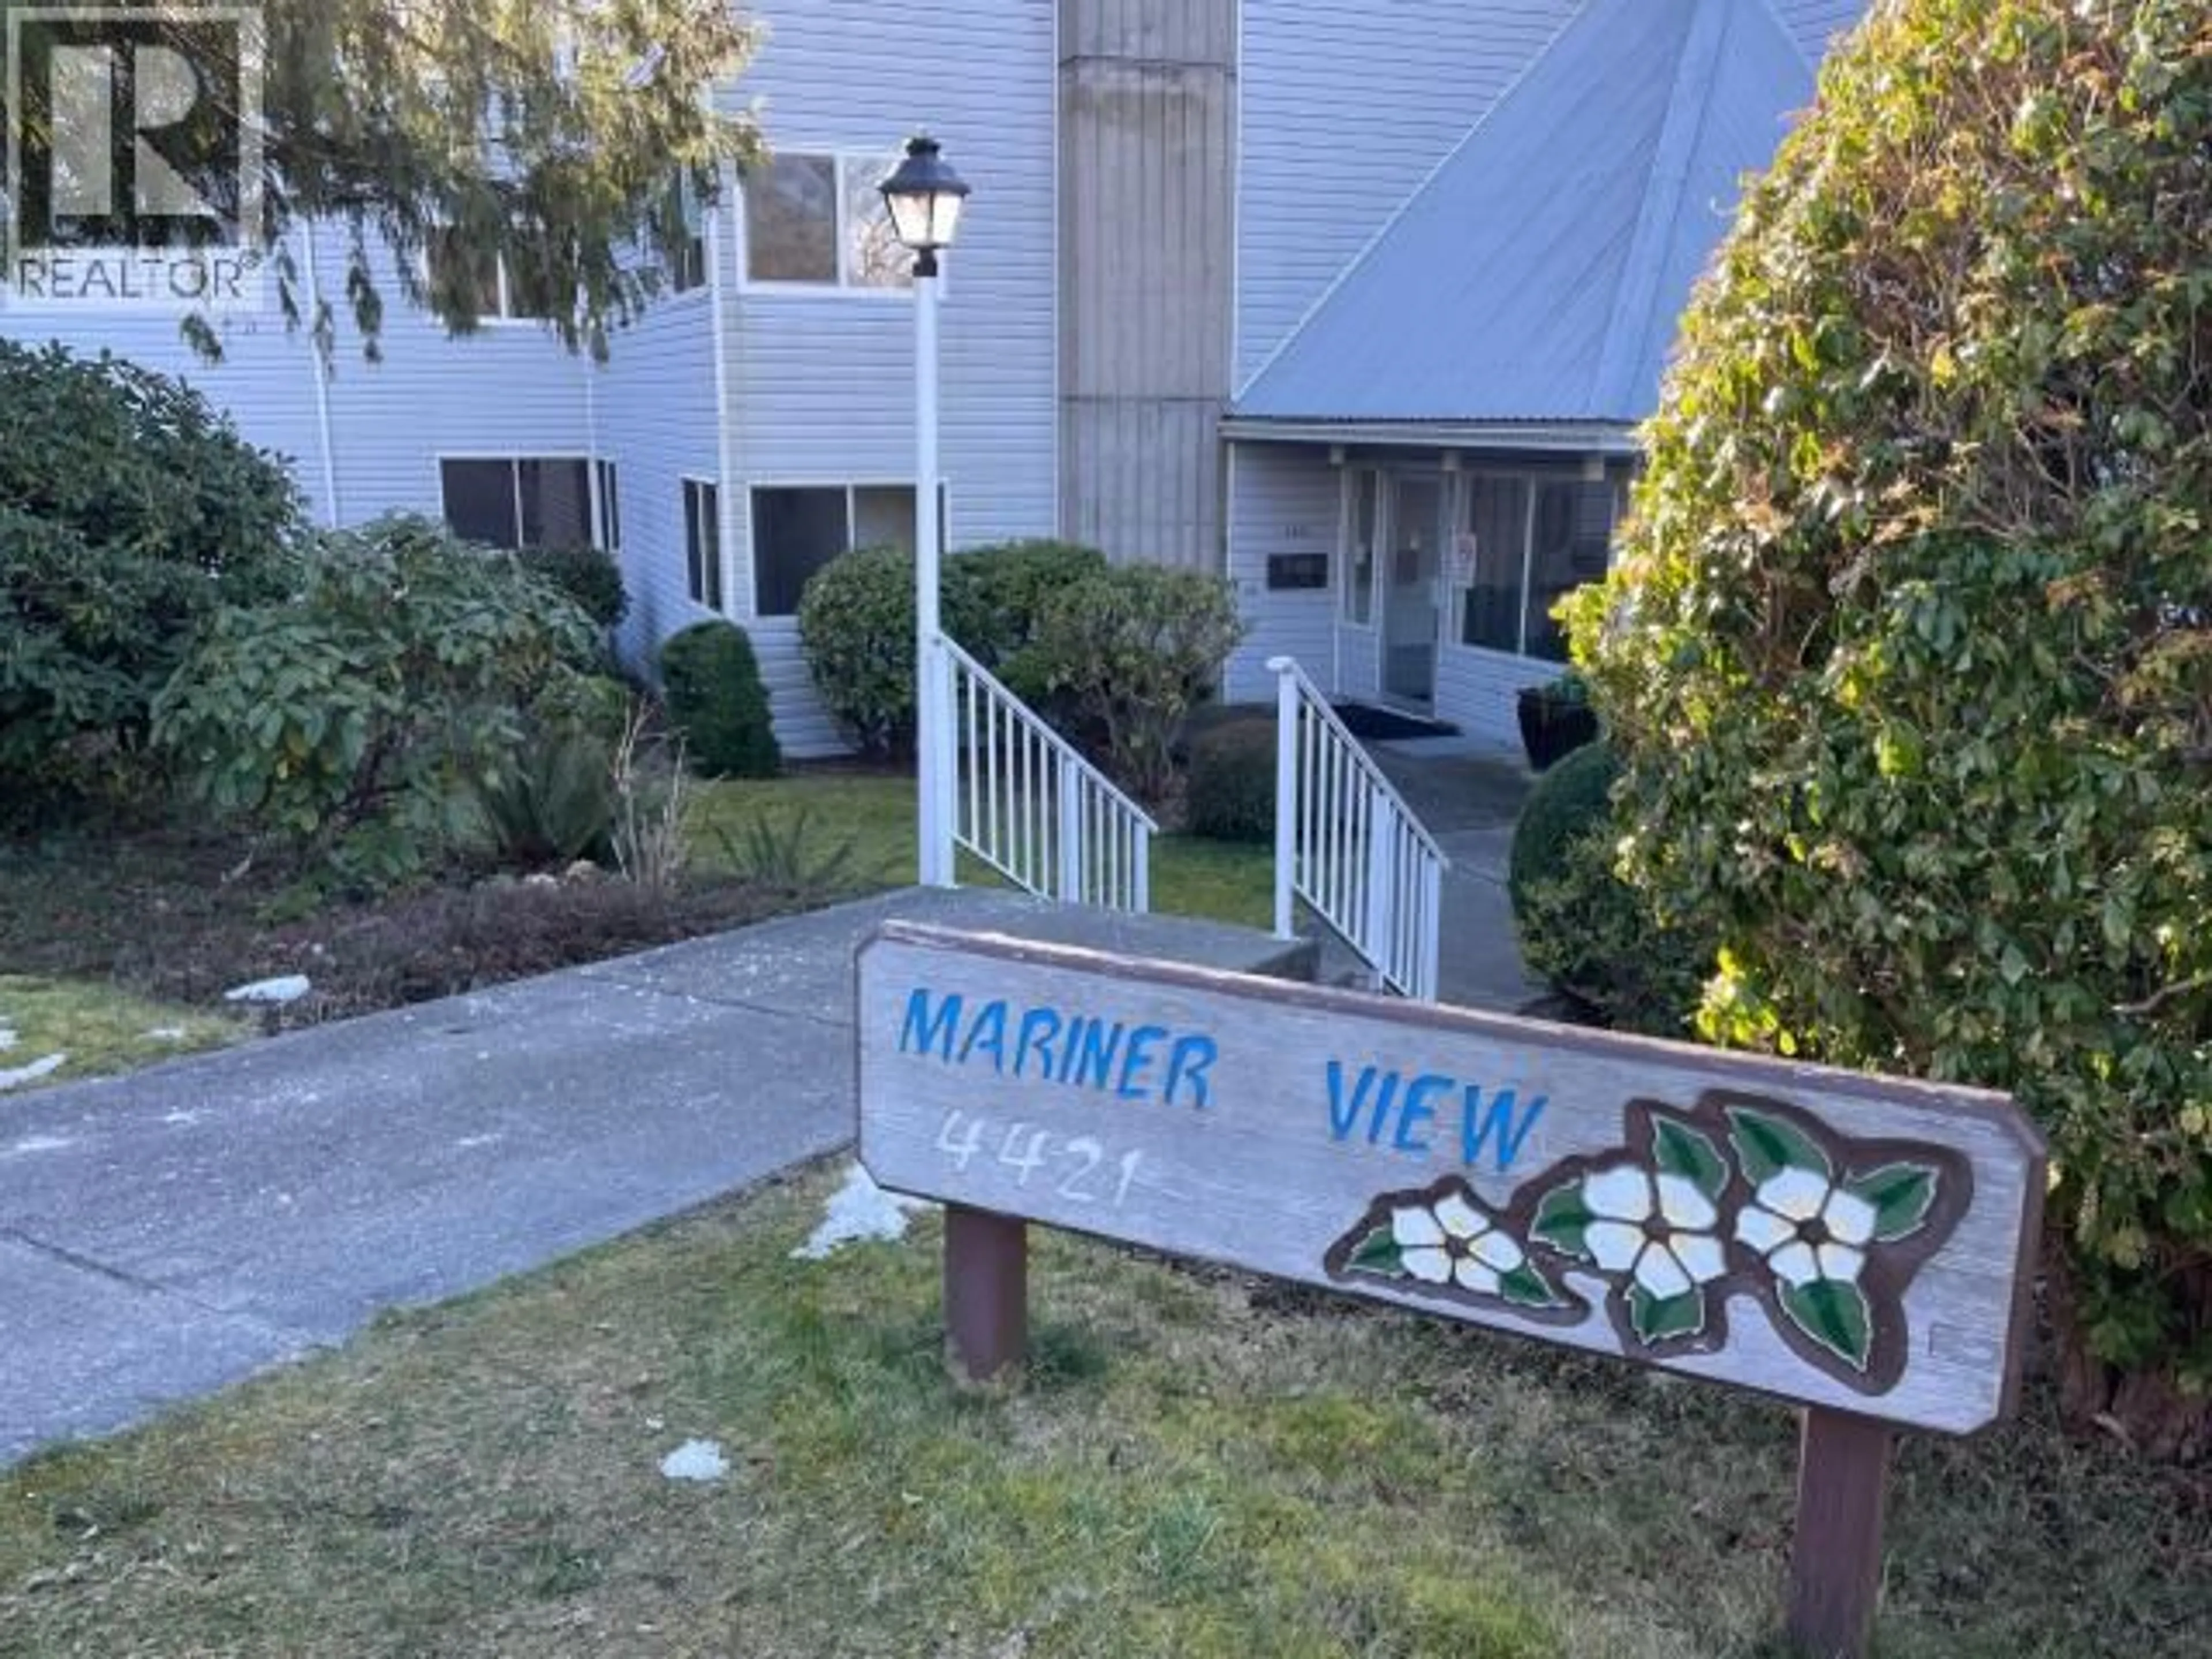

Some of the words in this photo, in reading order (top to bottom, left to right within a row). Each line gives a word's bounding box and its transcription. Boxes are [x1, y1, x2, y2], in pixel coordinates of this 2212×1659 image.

[899, 987, 1218, 1109] MARINER
[1327, 1060, 1550, 1172] VIEW
[935, 1109, 1141, 1206] 4421
